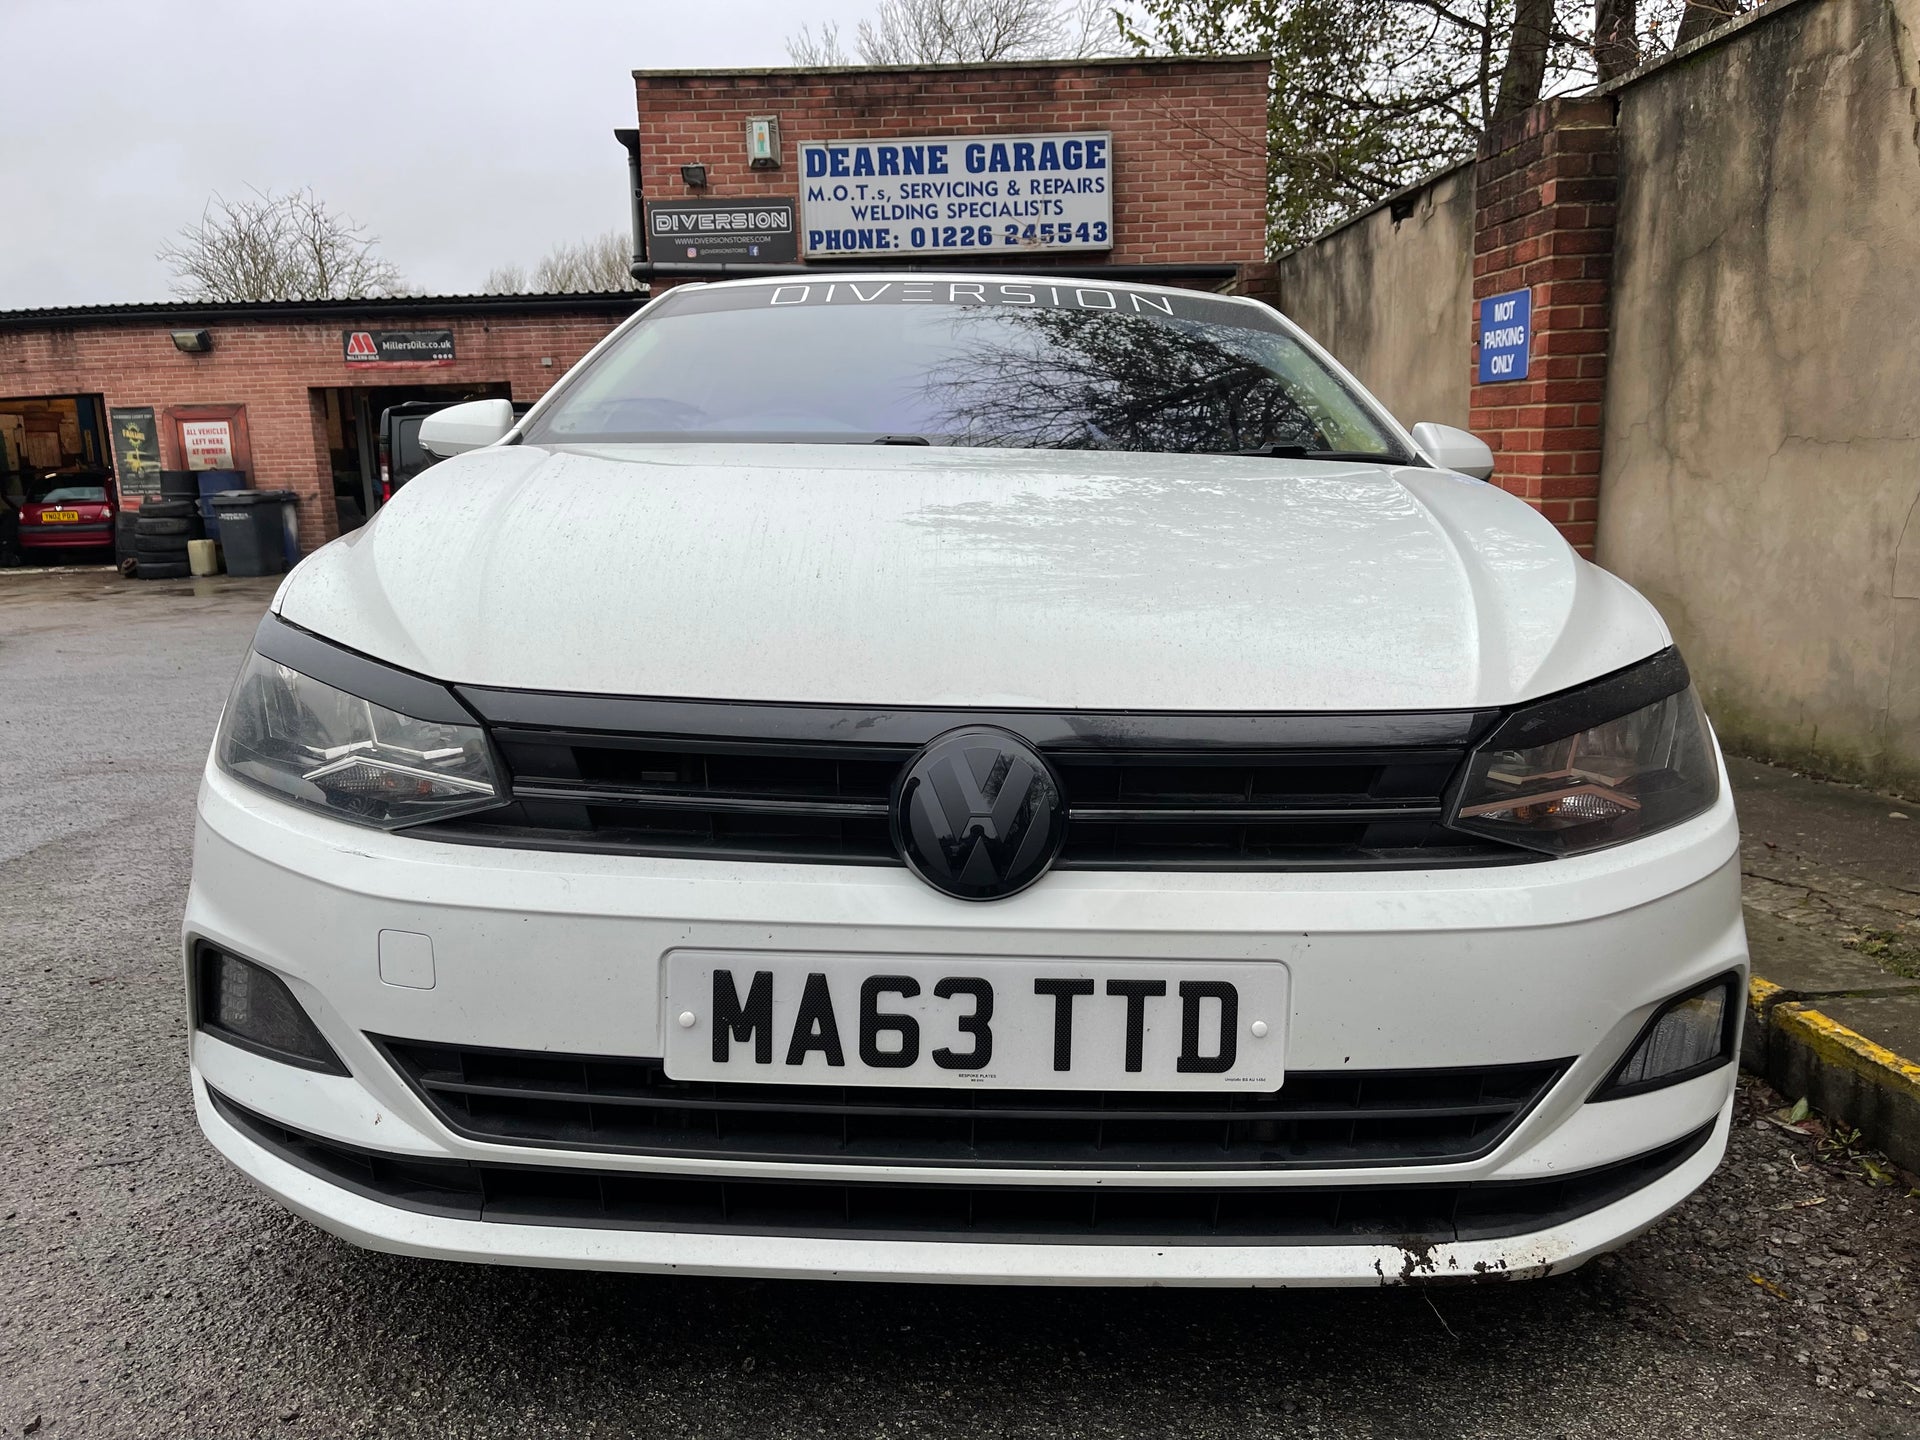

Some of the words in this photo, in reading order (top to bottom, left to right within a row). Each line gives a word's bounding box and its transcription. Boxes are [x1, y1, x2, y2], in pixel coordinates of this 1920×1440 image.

[805, 144, 949, 178] DEARNE
[965, 139, 1106, 174] GARAGE
[900, 181, 999, 200] SERVICING
[1007, 179, 1021, 196] &
[1030, 177, 1105, 195] REPAIRS
[851, 203, 939, 221] WELDING
[947, 199, 1064, 219] SPECIALISTS
[655, 212, 788, 231] DIVERSION
[674, 236, 772, 246] WWW.DIVERSIONSTORES.COM
[808, 228, 900, 250] PHONE:
[910, 225, 993, 248] 01226
[1004, 221, 1108, 246] 245543
[770, 282, 1175, 316] DIVERSION
[1494, 300, 1516, 322] MOT
[382, 340, 452, 350] MillersOils.co.uk
[1484, 325, 1525, 350] PARKING
[1491, 353, 1515, 375] ONLY
[192, 438, 207, 446] LEFT
[198, 427, 228, 435] VEHICLES
[192, 448, 200, 456] AT
[711, 968, 995, 1070] MA63
[1033, 977, 1239, 1074] TTD
